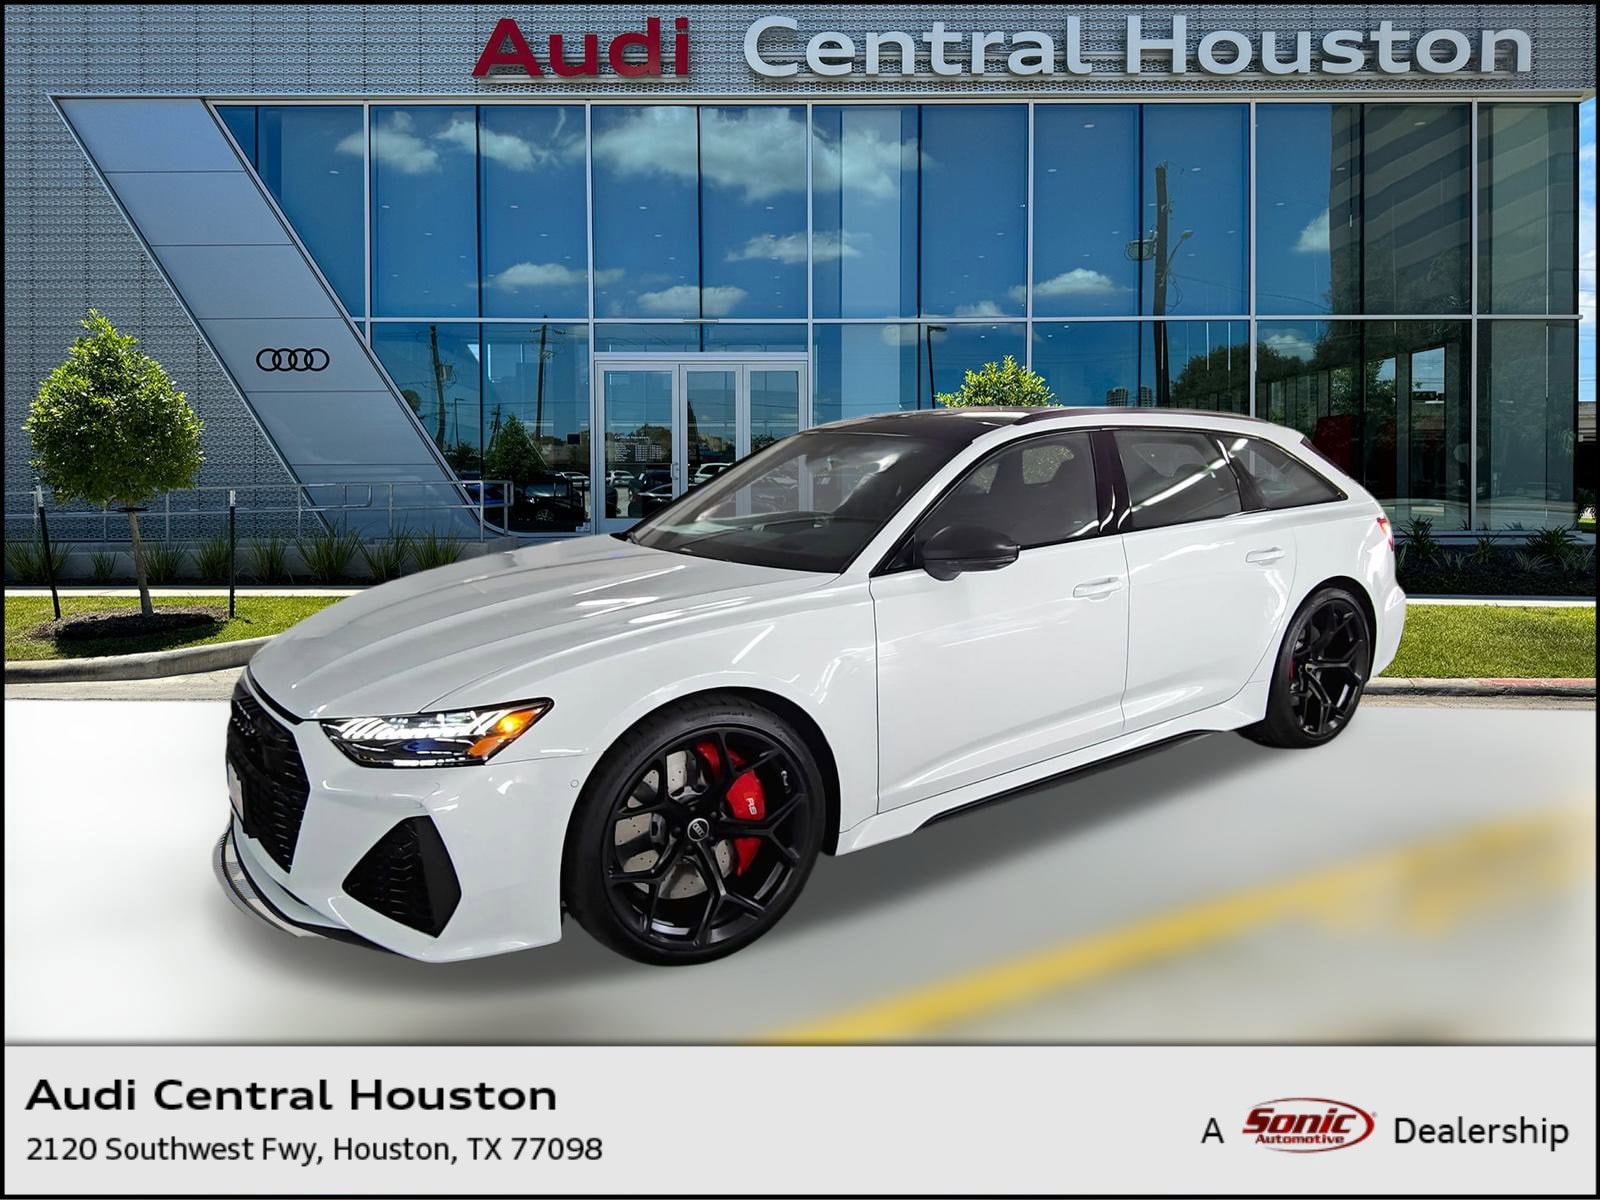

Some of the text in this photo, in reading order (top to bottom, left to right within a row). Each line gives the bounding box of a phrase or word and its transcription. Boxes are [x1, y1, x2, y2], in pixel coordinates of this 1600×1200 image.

[471, 15, 1532, 78] Audi Central Houston
